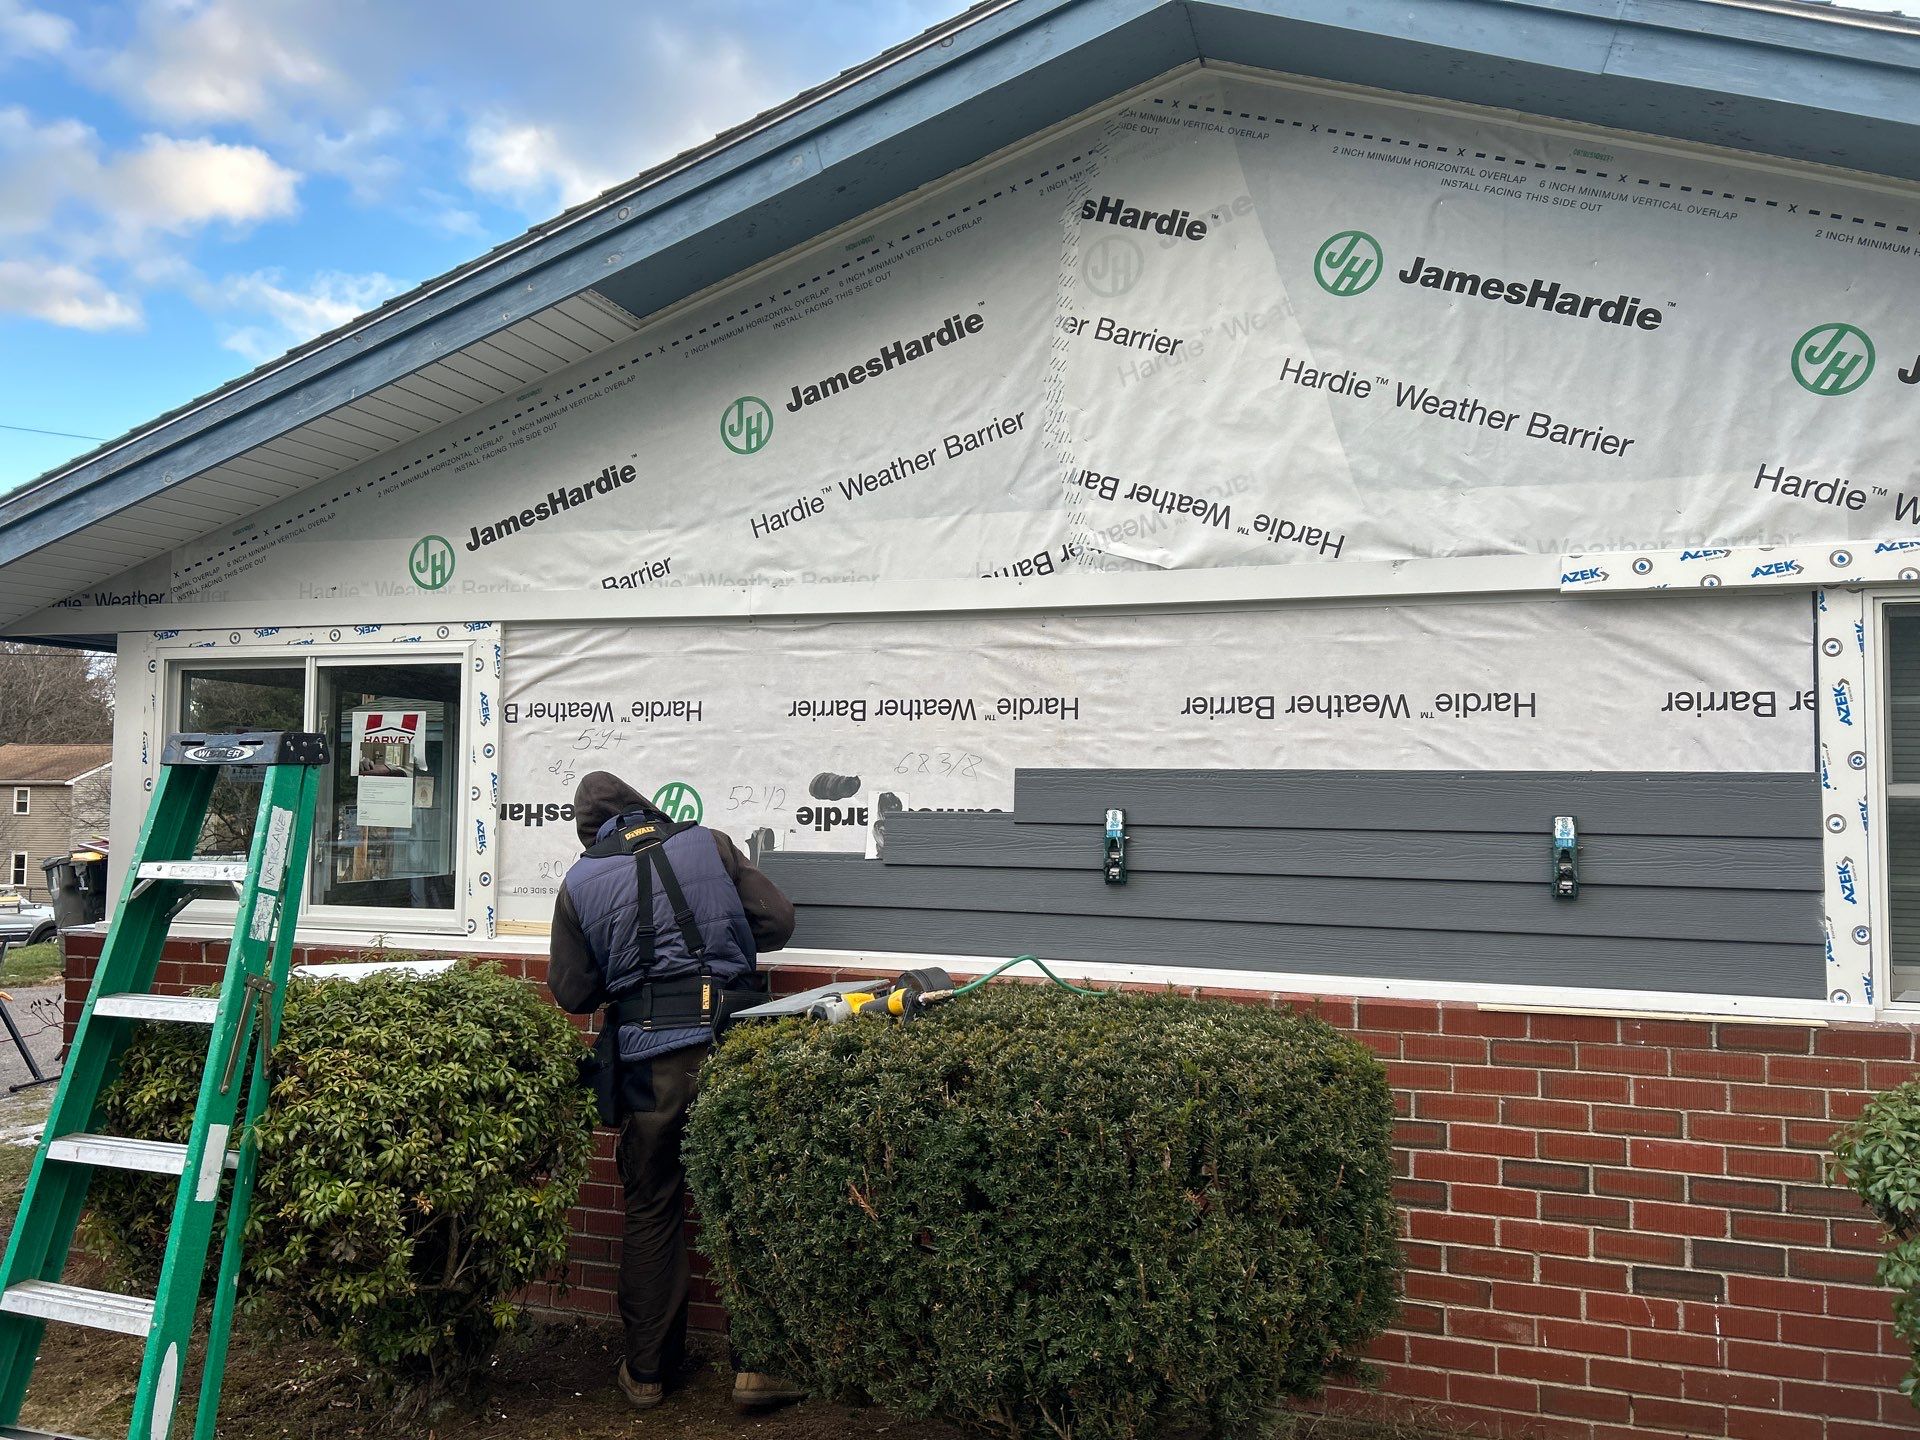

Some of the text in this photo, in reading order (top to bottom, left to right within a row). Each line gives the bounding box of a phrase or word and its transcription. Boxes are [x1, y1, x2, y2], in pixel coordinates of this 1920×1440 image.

[1138, 112, 1181, 126] MINIMUM
[1182, 118, 1225, 134] VERTICAL
[1227, 126, 1270, 141] OVERLAP
[1140, 125, 1159, 135] OUT
[1332, 146, 1527, 185] 2 INCH MINIMUM HORIZONTAL OVERLAP
[1045, 178, 1068, 194] INCH
[1440, 178, 1604, 212] INSTALL FACING THIS SIDE OUT
[1539, 179, 1738, 221] 6 INCH MINIMUM VERTICAL OVERLAP
[838, 216, 983, 288] 6 INCH MINIMUM VERTICAL OVERLAP
[1815, 229, 1823, 238] 2
[1825, 230, 1855, 244] INCH
[1857, 237, 1910, 255] MINIMUM
[772, 269, 893, 331] INSTALL FACING THIS SIDE OUT
[684, 286, 830, 359] 2 INCH MINIMUM HORIZONTAL OVERLAP
[1094, 316, 1184, 356] Barrier
[518, 421, 535, 434] INCH
[536, 406, 568, 425] MINIMUM
[569, 391, 603, 410] VERTICAL
[604, 374, 637, 394] OVERLAP
[1396, 381, 1519, 433] Weather
[1526, 411, 1635, 458] Barrier
[453, 421, 559, 474] INSTALL FACING THIS SIDE OUT
[837, 447, 937, 501] Weather
[943, 411, 1025, 460] Barrier
[377, 435, 504, 498] 2 INCH MINIMUM HORIZONTAL OVERLAP
[1124, 481, 1232, 530] Weather
[232, 553, 248, 566] INCH
[248, 541, 276, 558] MINIMUM
[277, 528, 306, 544] VERTICAL
[307, 512, 336, 530] OVERLAP
[176, 588, 200, 602] INSTALL
[201, 577, 223, 592] FACING
[224, 569, 238, 580] THIS
[239, 562, 253, 574] SIDE
[254, 555, 268, 567] OUT
[193, 567, 221, 584] OVERLAP
[601, 557, 671, 589] Barrier
[1561, 567, 1601, 584] AZEK
[1751, 559, 1797, 579] AZEK
[480, 691, 491, 722] AZEK
[525, 701, 615, 723] Weather
[788, 699, 867, 722] Barrier
[875, 698, 977, 721] Weather
[1181, 694, 1274, 719] Barrier
[1284, 693, 1411, 719] Weather
[1661, 690, 1777, 718] Barrier
[1832, 685, 1853, 727] AZEK
[364, 736, 415, 744] HARVEY
[476, 819, 487, 850] AZEK
[512, 887, 529, 895] OUT
[530, 887, 547, 895] SIDE
[1836, 862, 1857, 905] AZEK
